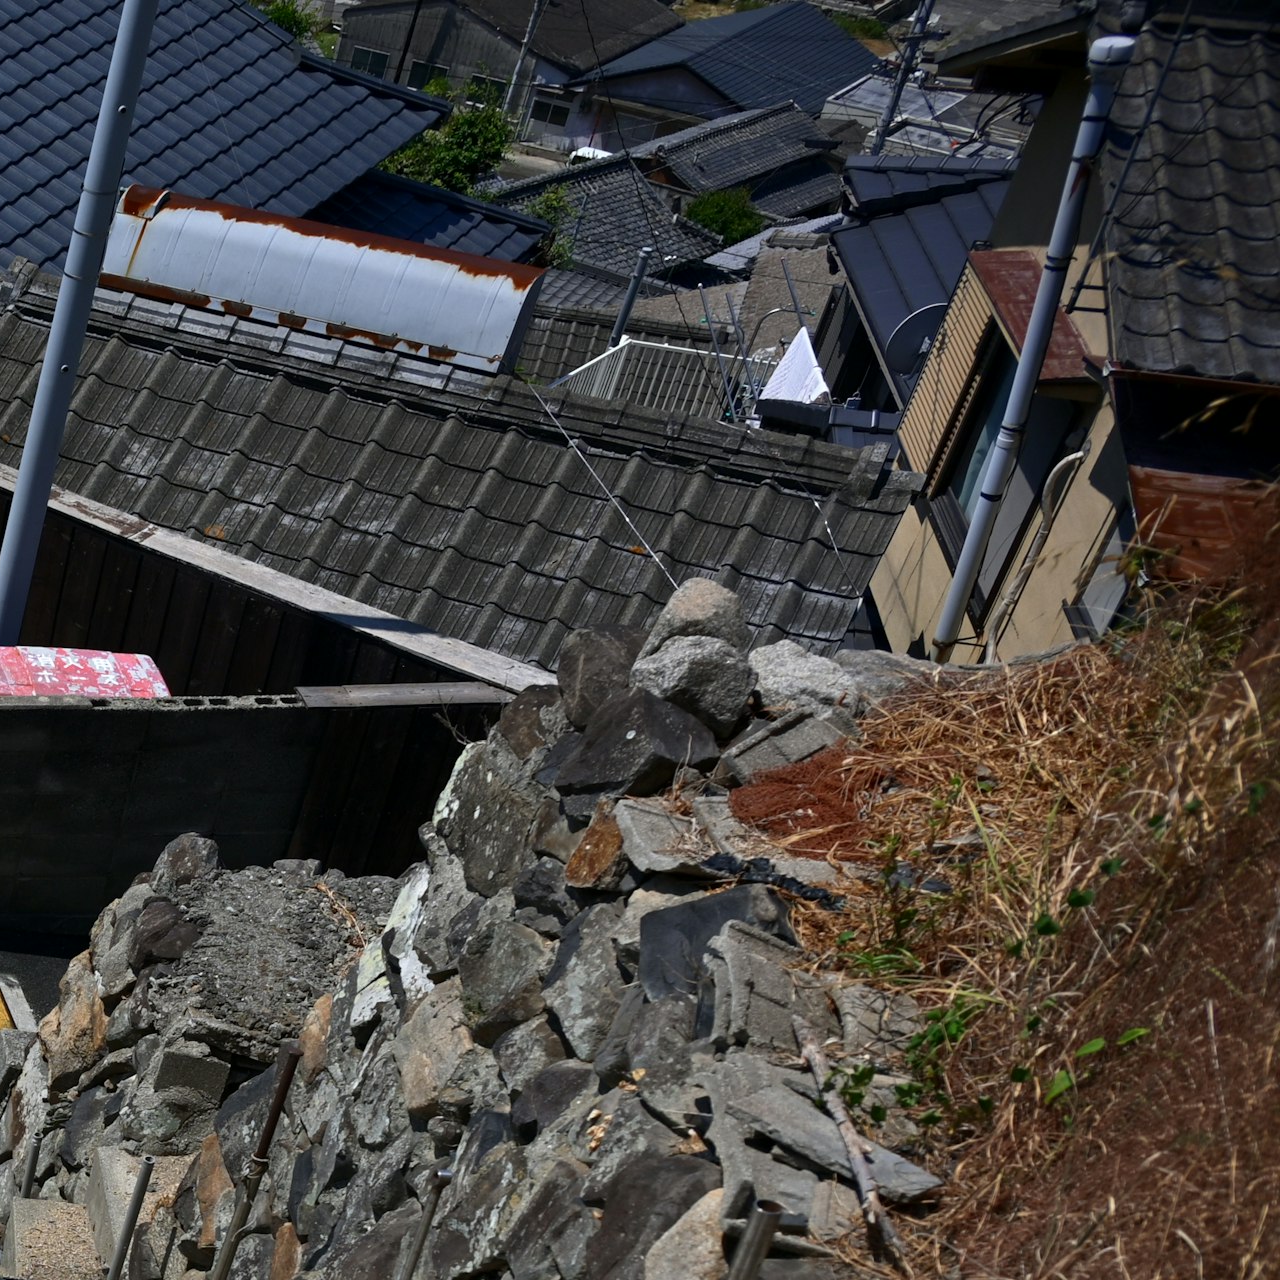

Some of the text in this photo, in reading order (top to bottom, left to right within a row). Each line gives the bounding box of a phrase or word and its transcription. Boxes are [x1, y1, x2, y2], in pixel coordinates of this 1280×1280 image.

[28, 653, 114, 671] 消火用
[37, 671, 119, 685] ホース
